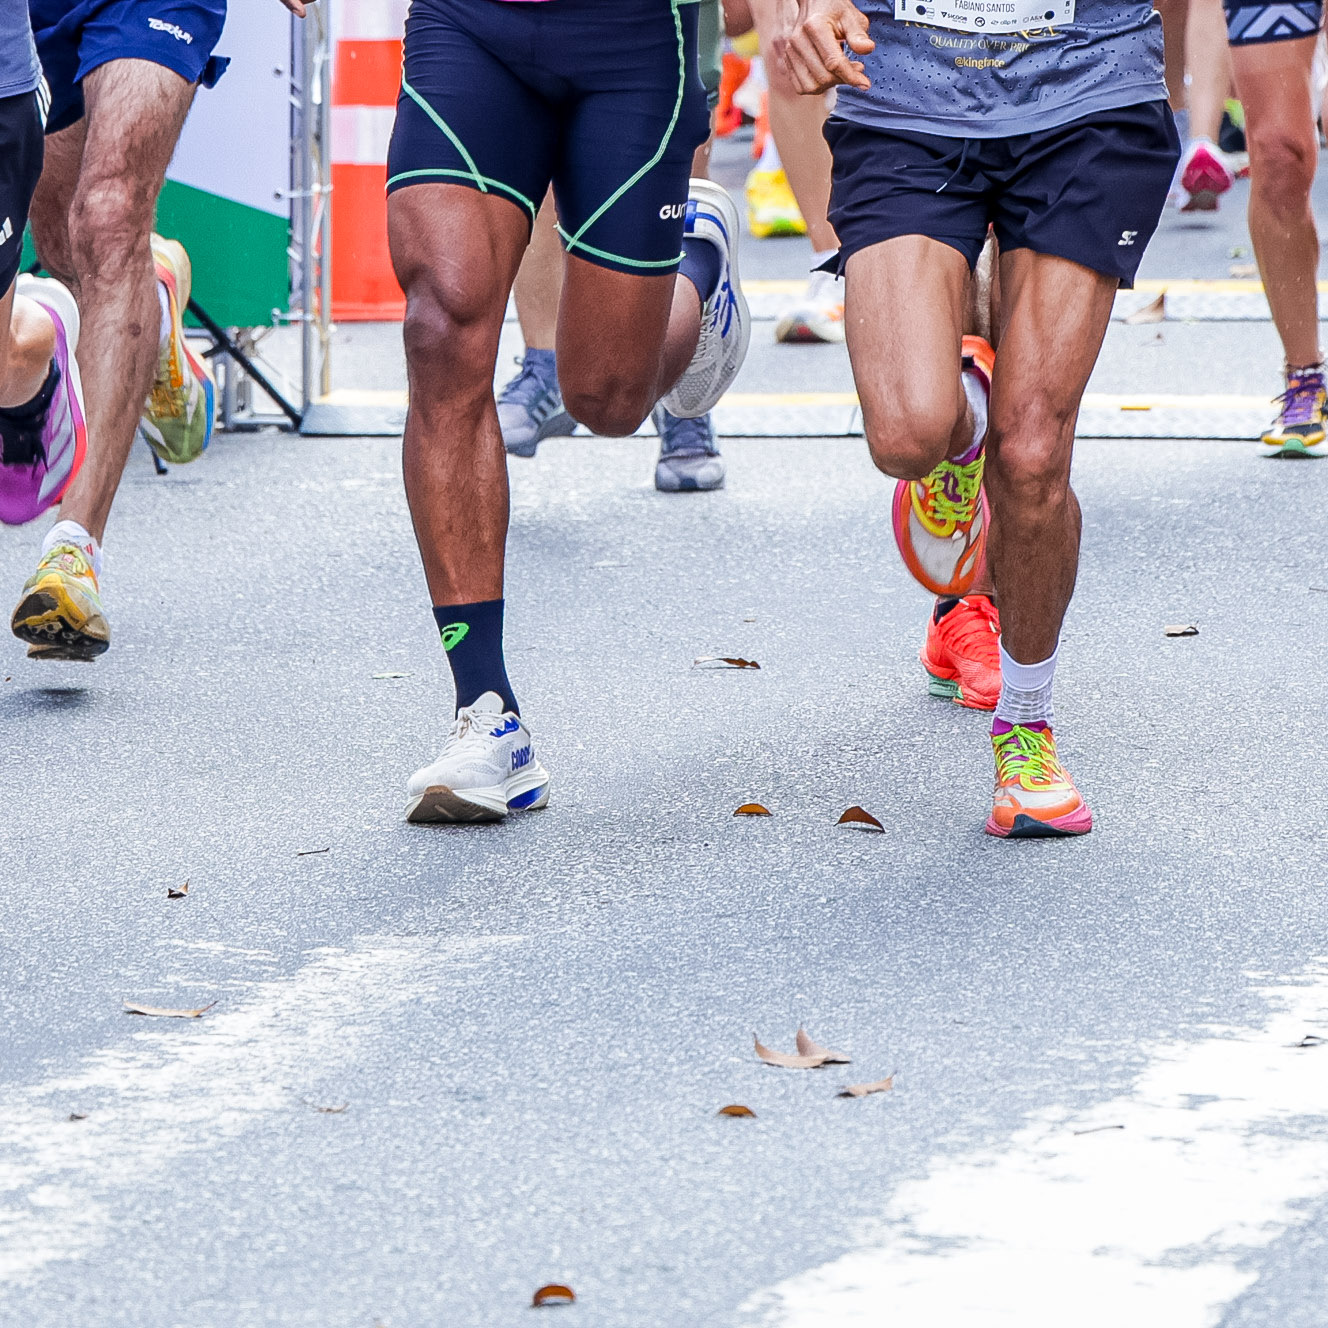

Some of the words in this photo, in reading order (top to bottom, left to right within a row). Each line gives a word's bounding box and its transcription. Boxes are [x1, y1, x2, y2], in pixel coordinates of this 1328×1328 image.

[955, 0, 985, 12] FABIANO
[986, 3, 1015, 13] SANTOS
[929, 35, 976, 49] QUALITY
[978, 36, 1007, 50] OVER
